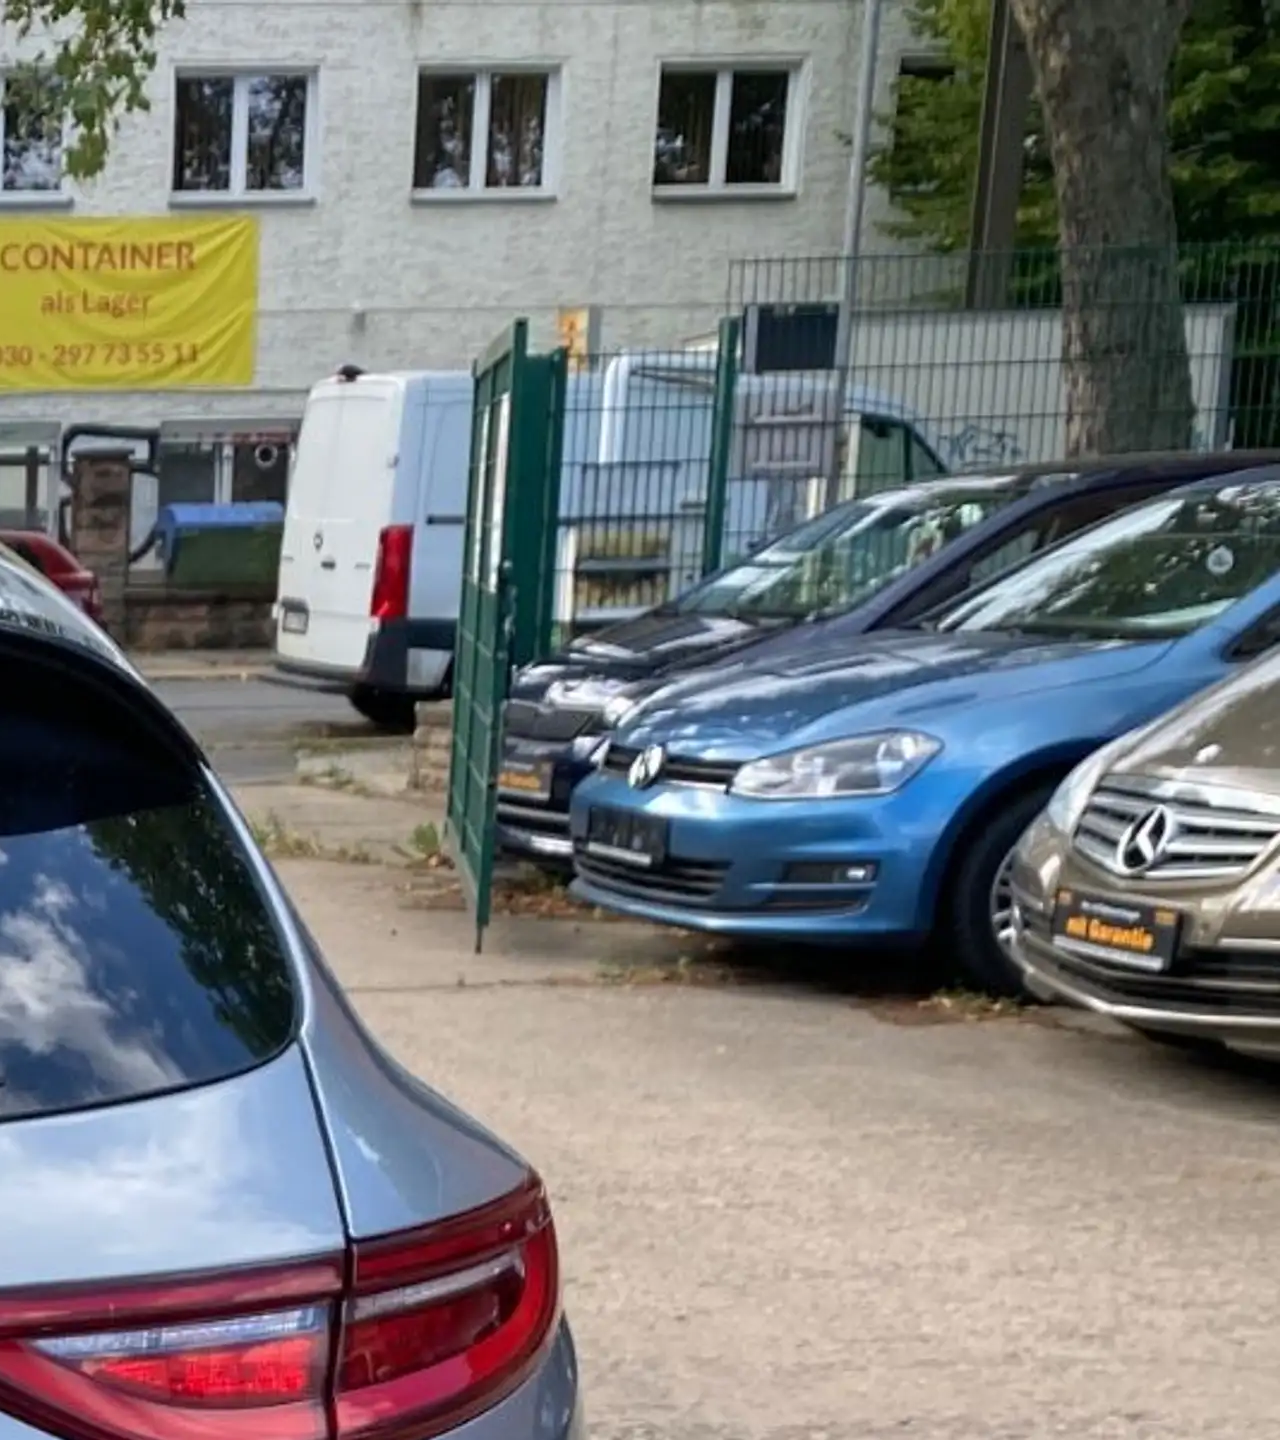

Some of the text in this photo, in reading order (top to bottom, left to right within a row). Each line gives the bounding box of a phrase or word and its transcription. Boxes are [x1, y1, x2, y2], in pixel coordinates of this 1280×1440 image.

[0, 241, 197, 271] CONTAINER
[40, 289, 150, 318] als Lager
[53, 344, 96, 366] 297
[104, 343, 131, 365] 73
[140, 342, 166, 364] 55
